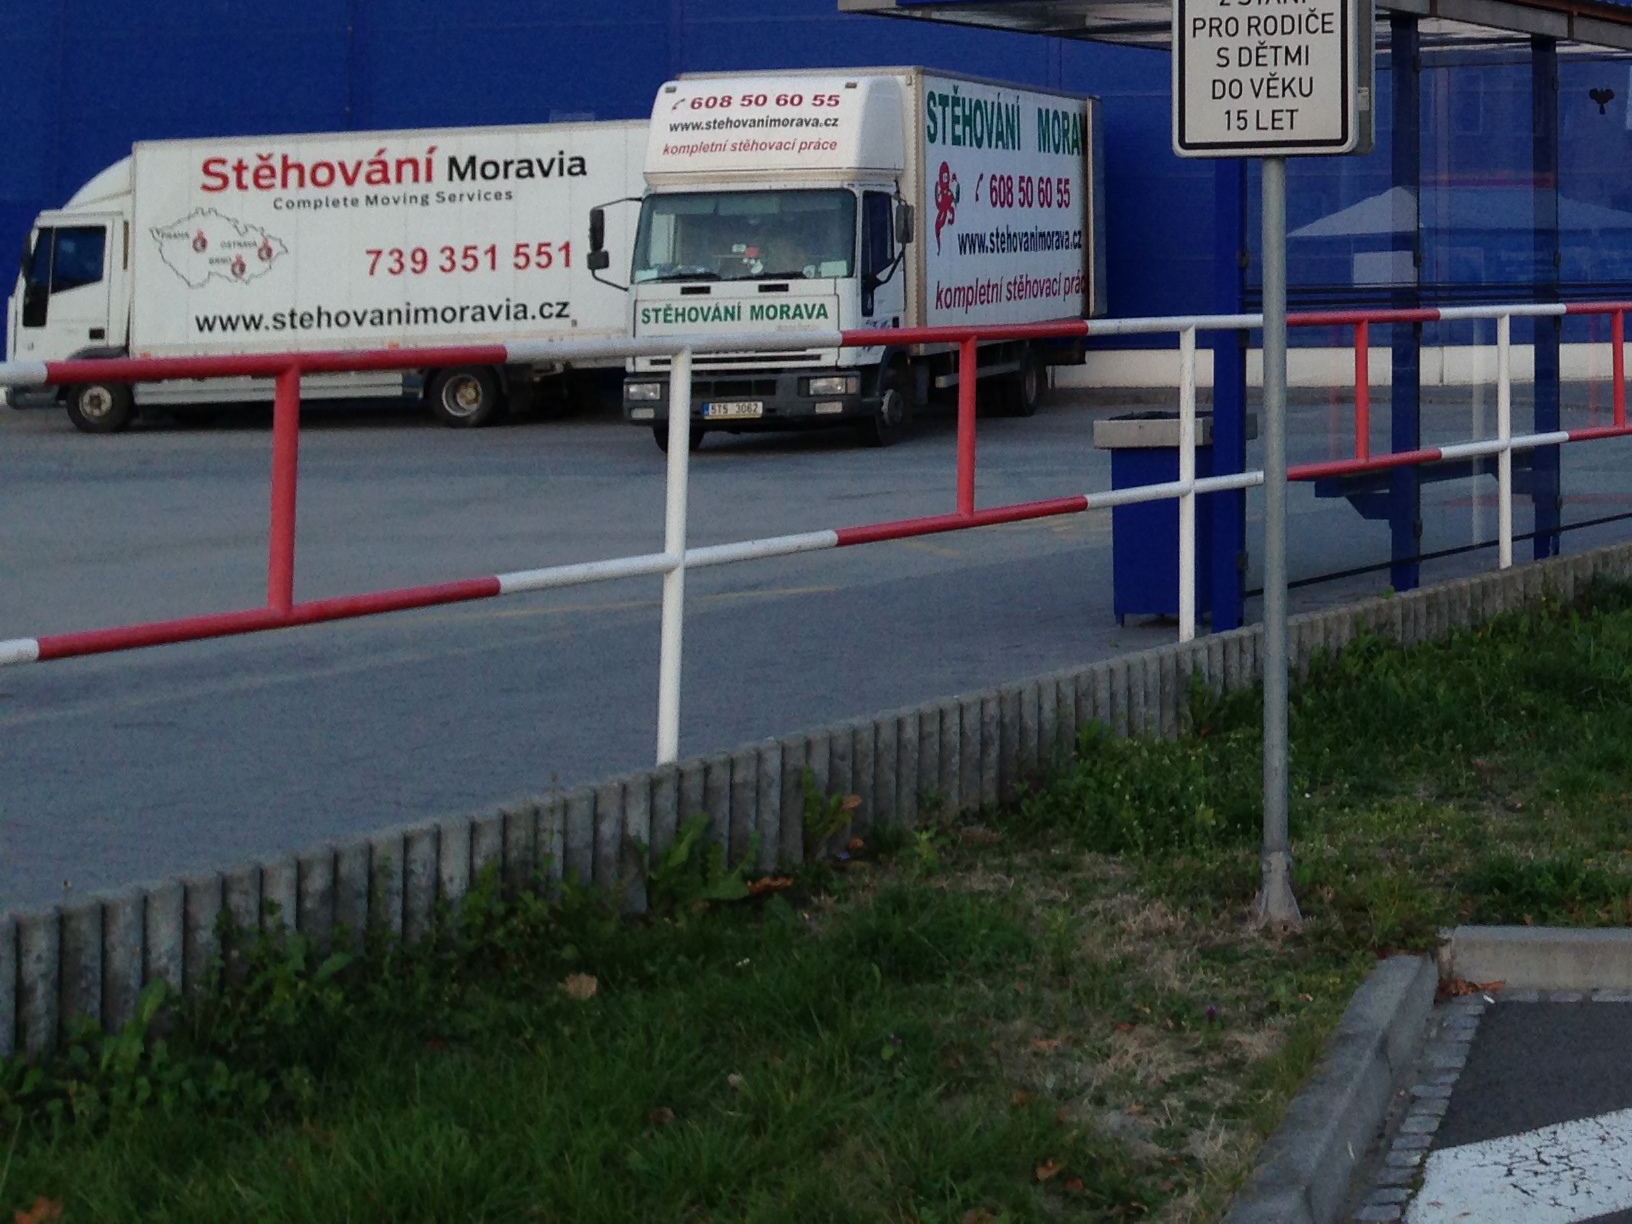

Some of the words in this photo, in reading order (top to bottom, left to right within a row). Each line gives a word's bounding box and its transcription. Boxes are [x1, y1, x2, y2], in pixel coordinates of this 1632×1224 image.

[1192, 18, 1240, 38] PRO
[1247, 9, 1335, 36] RODIČE
[1216, 46, 1231, 68] S
[1237, 39, 1310, 67] DĚTMI
[690, 95, 733, 110] 608
[740, 94, 768, 107] 50
[775, 93, 803, 107] 60
[811, 94, 841, 107] 55
[1212, 79, 1244, 100] DO
[1250, 75, 1314, 99] VĚKU
[926, 85, 1021, 151] STĚHOVÁNÍ
[1224, 109, 1248, 132] 15
[1255, 108, 1300, 131] LET
[663, 139, 728, 156] kompletní
[730, 138, 796, 152] stěhovací
[798, 138, 838, 153] práce
[201, 146, 438, 192] Stěhování
[447, 150, 588, 182] Moravia
[273, 196, 360, 210] Complete
[365, 192, 430, 207] Moving
[436, 188, 514, 204] Services
[989, 173, 1014, 208] 608
[1018, 175, 1034, 208] 50
[1037, 176, 1053, 208] 60
[1056, 177, 1071, 208] 55
[366, 249, 430, 276] 739
[439, 245, 499, 273] 351
[513, 241, 574, 270] 551
[935, 277, 1003, 314] kompletní
[1006, 273, 1061, 302] stěhovací
[195, 300, 571, 332] www.stehovanimoravia.cz
[641, 302, 742, 325] STĚHOVÁNÍ
[750, 302, 829, 320] MORAVA
